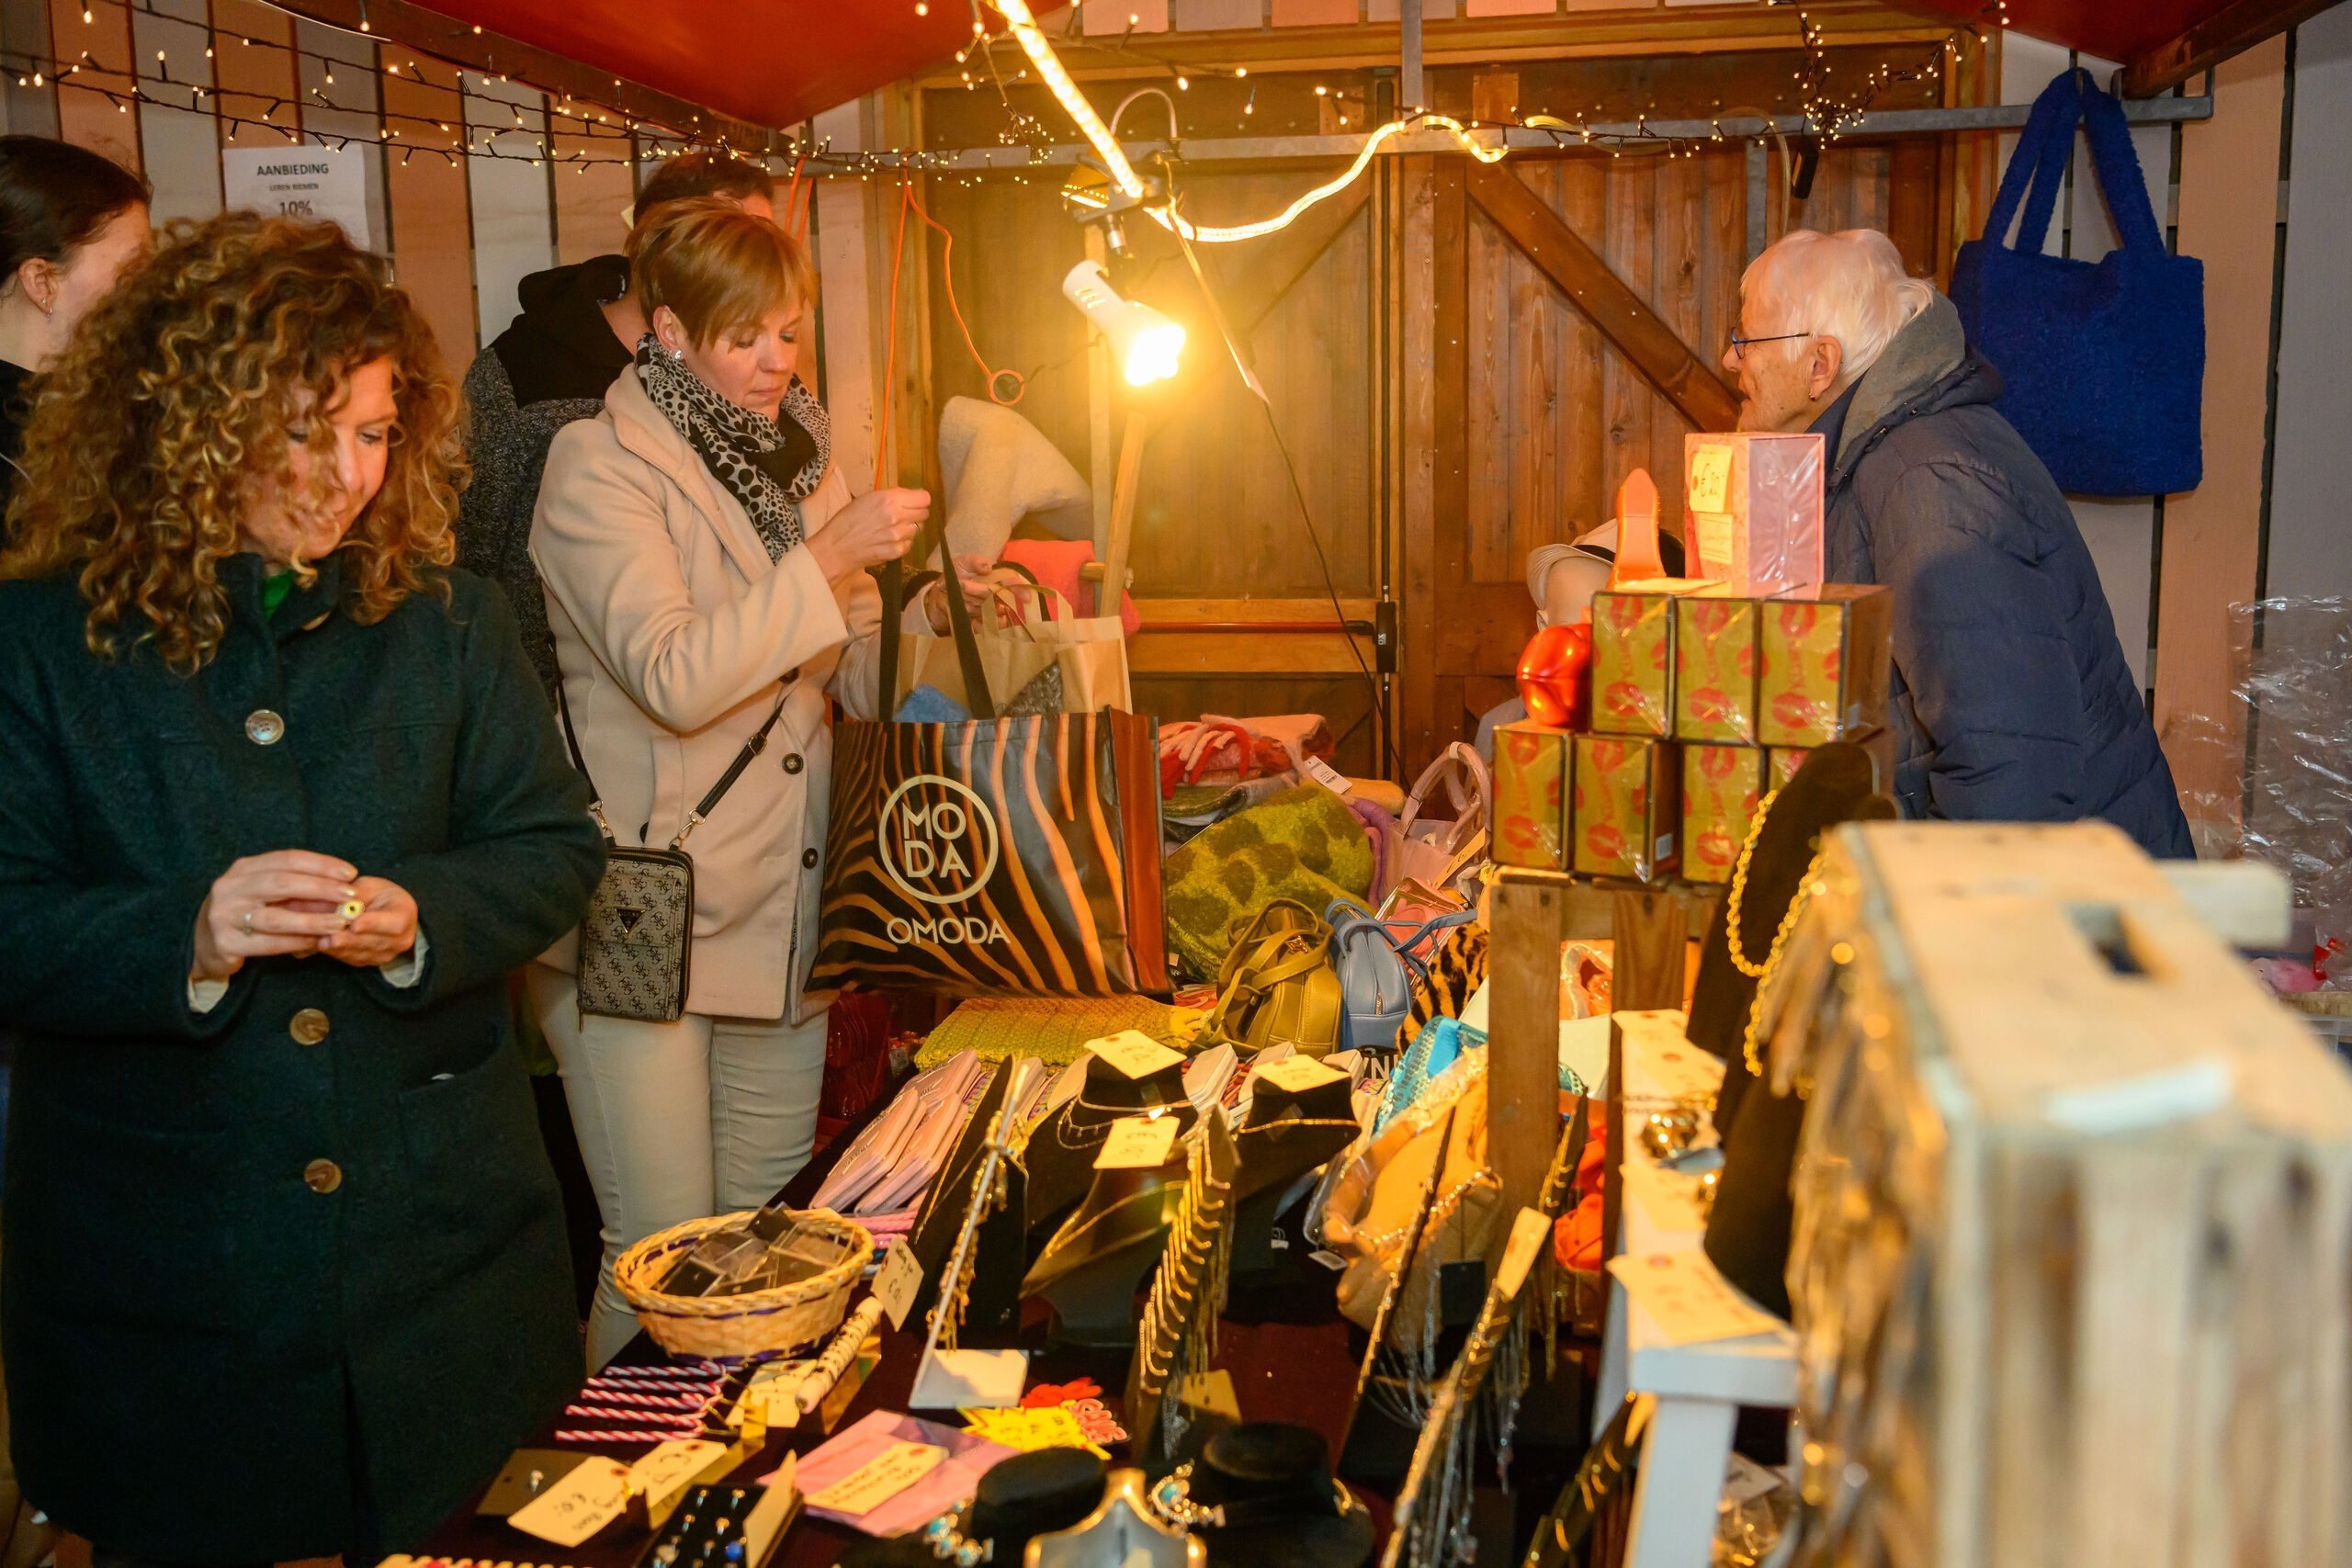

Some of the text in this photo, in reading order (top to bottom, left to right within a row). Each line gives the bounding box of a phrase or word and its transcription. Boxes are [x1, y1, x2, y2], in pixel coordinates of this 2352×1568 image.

[257, 164, 329, 175] AANBIEDING
[279, 199, 313, 216] 10%
[902, 802, 966, 840] MO
[904, 840, 971, 878] DA
[887, 917, 1011, 944] OMODA
